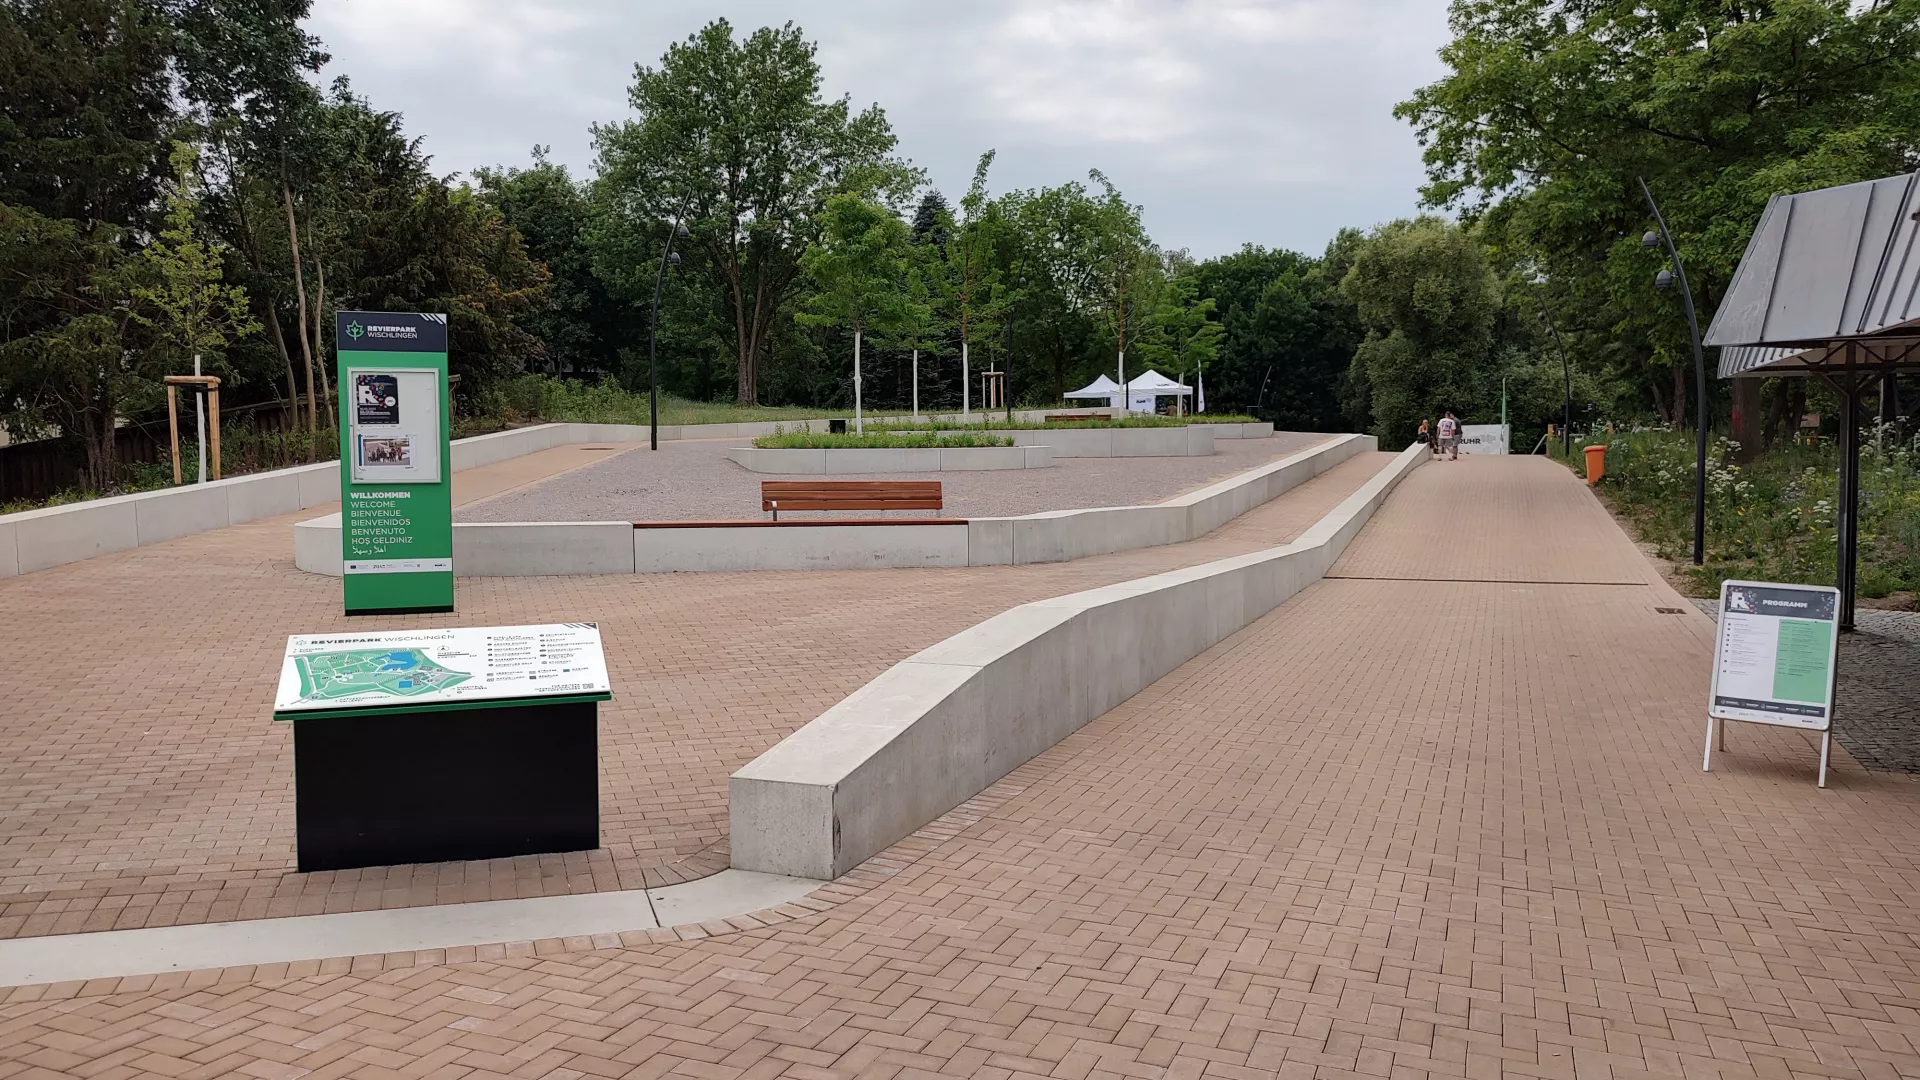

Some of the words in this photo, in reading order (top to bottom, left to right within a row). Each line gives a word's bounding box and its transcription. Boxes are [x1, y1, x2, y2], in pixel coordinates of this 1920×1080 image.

[367, 325, 417, 333] REVIERPARK
[367, 331, 418, 339] WISCHLINGEN
[359, 385, 379, 404] R
[350, 491, 411, 499] WILLKOMMEN
[1731, 591, 1750, 609] R
[1762, 599, 1808, 609] PROGRAMM
[311, 637, 382, 645] REVIERPARK
[384, 634, 455, 643] WISCHLINGEN
